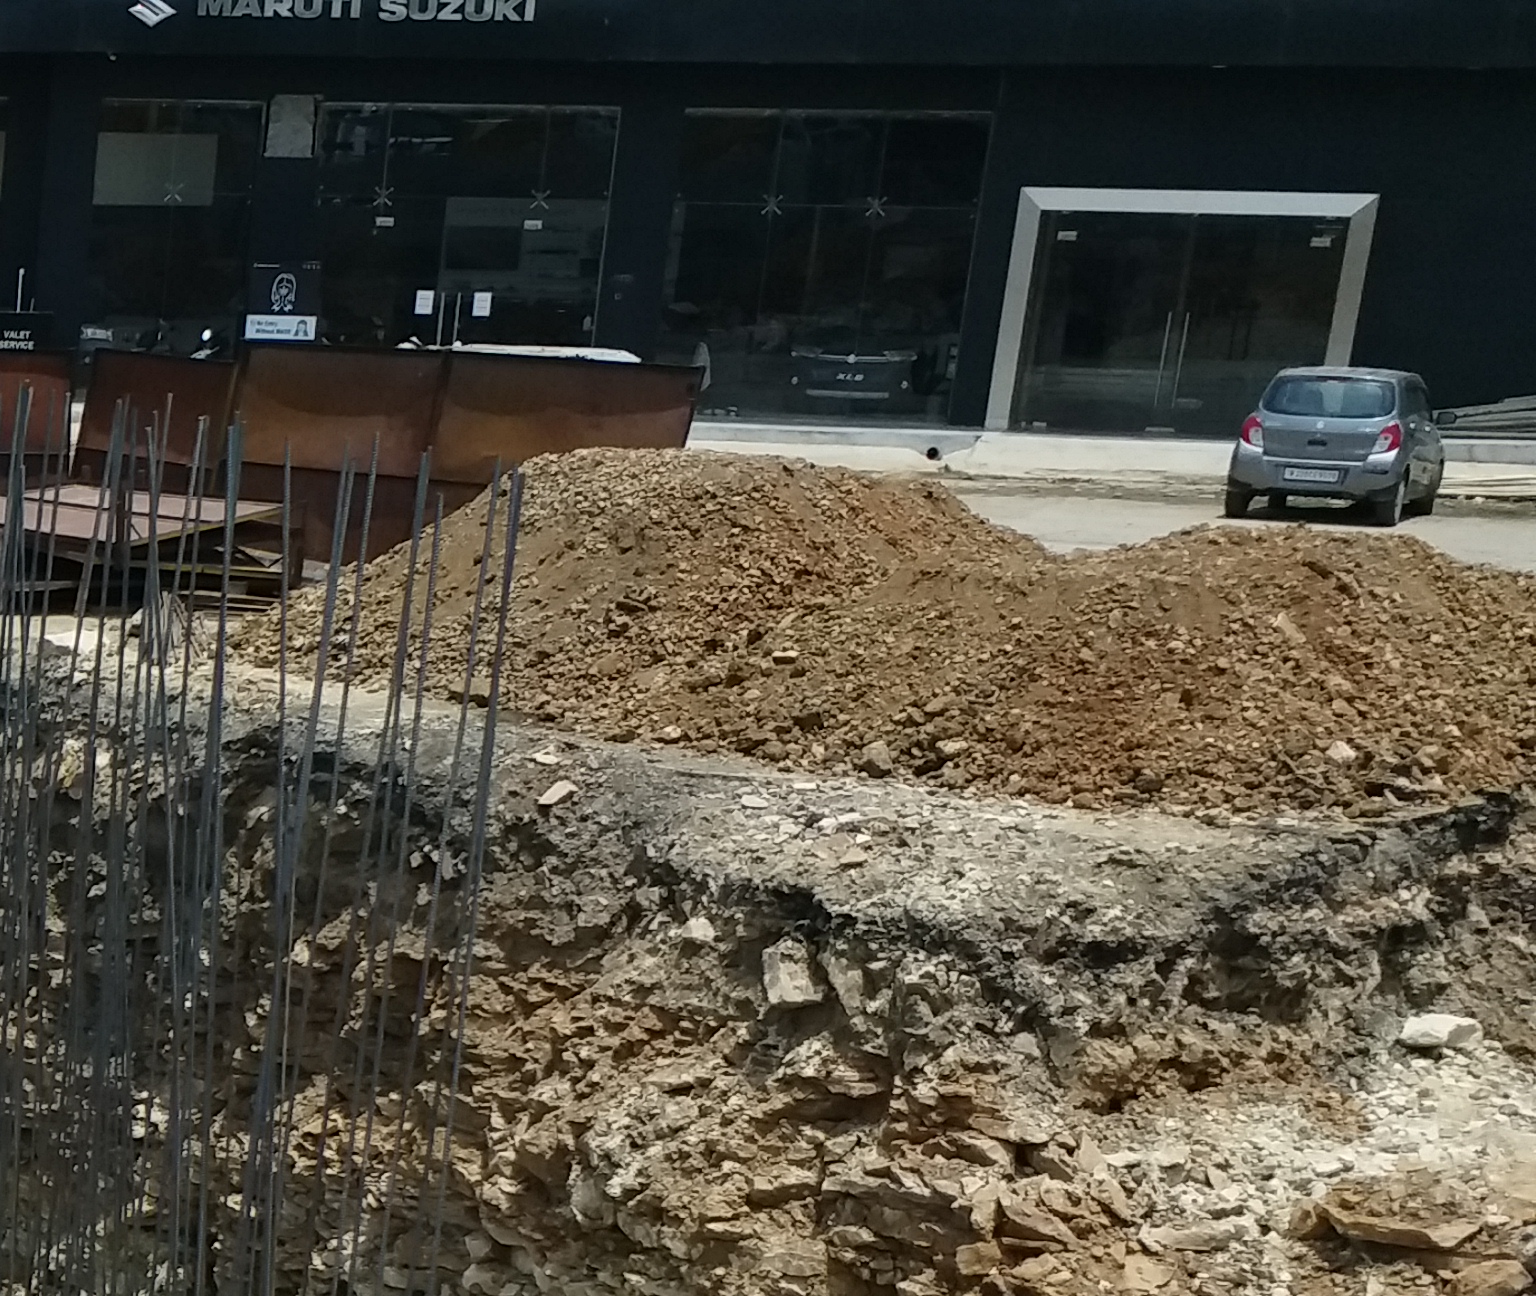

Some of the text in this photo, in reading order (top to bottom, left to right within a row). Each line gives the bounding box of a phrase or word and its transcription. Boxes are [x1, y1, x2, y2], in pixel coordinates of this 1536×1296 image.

[197, 0, 536, 22] MARUTI SUZUKI
[3, 330, 32, 340] VALET
